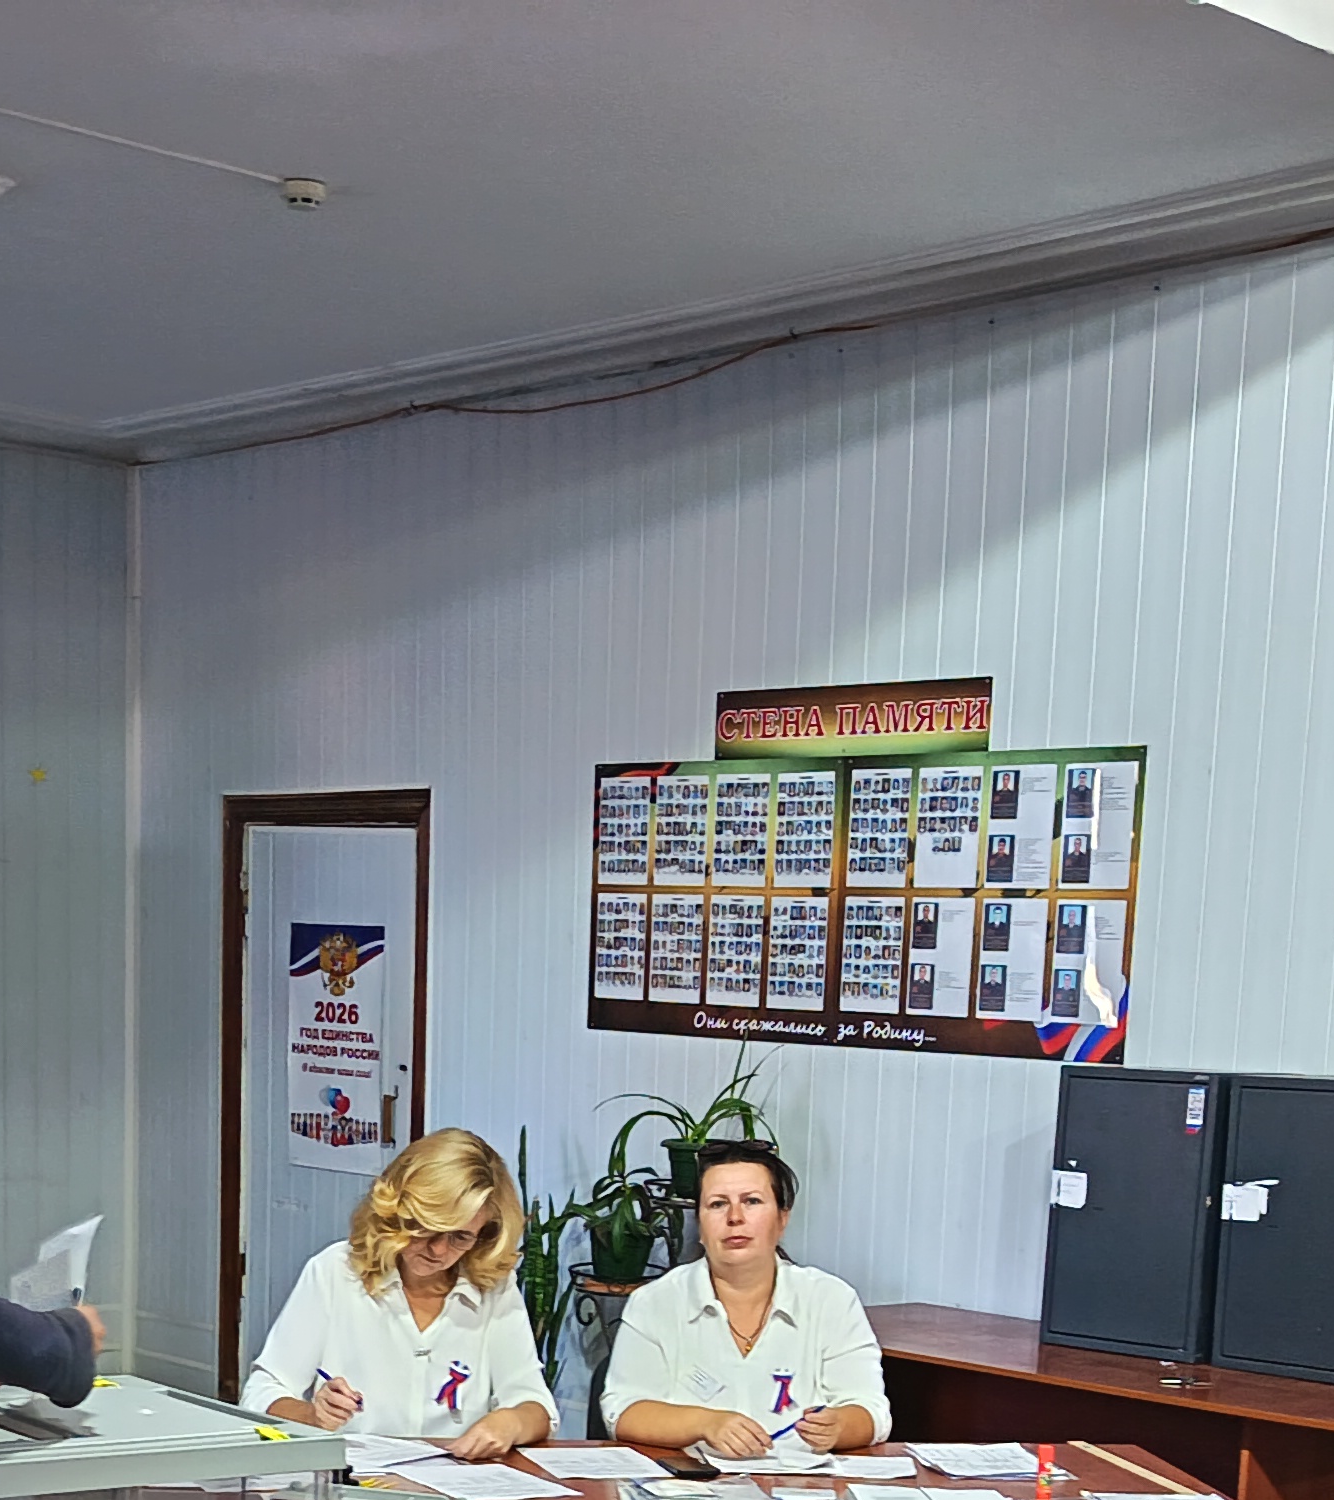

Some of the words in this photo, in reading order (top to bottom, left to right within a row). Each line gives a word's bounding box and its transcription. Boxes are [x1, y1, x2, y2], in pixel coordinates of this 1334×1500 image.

[718, 705, 827, 743] СТЕНА
[835, 696, 990, 737] ПАМЯТИ
[313, 1000, 359, 1025] 2026
[299, 1027, 320, 1041] ГОД
[321, 1028, 374, 1044] ЕДИНСТВА
[693, 1010, 729, 1030] Они
[732, 1016, 827, 1038] сражались
[836, 1022, 857, 1042] за
[291, 1042, 338, 1059] НАРОДОВ
[340, 1047, 381, 1062] РОССИИ
